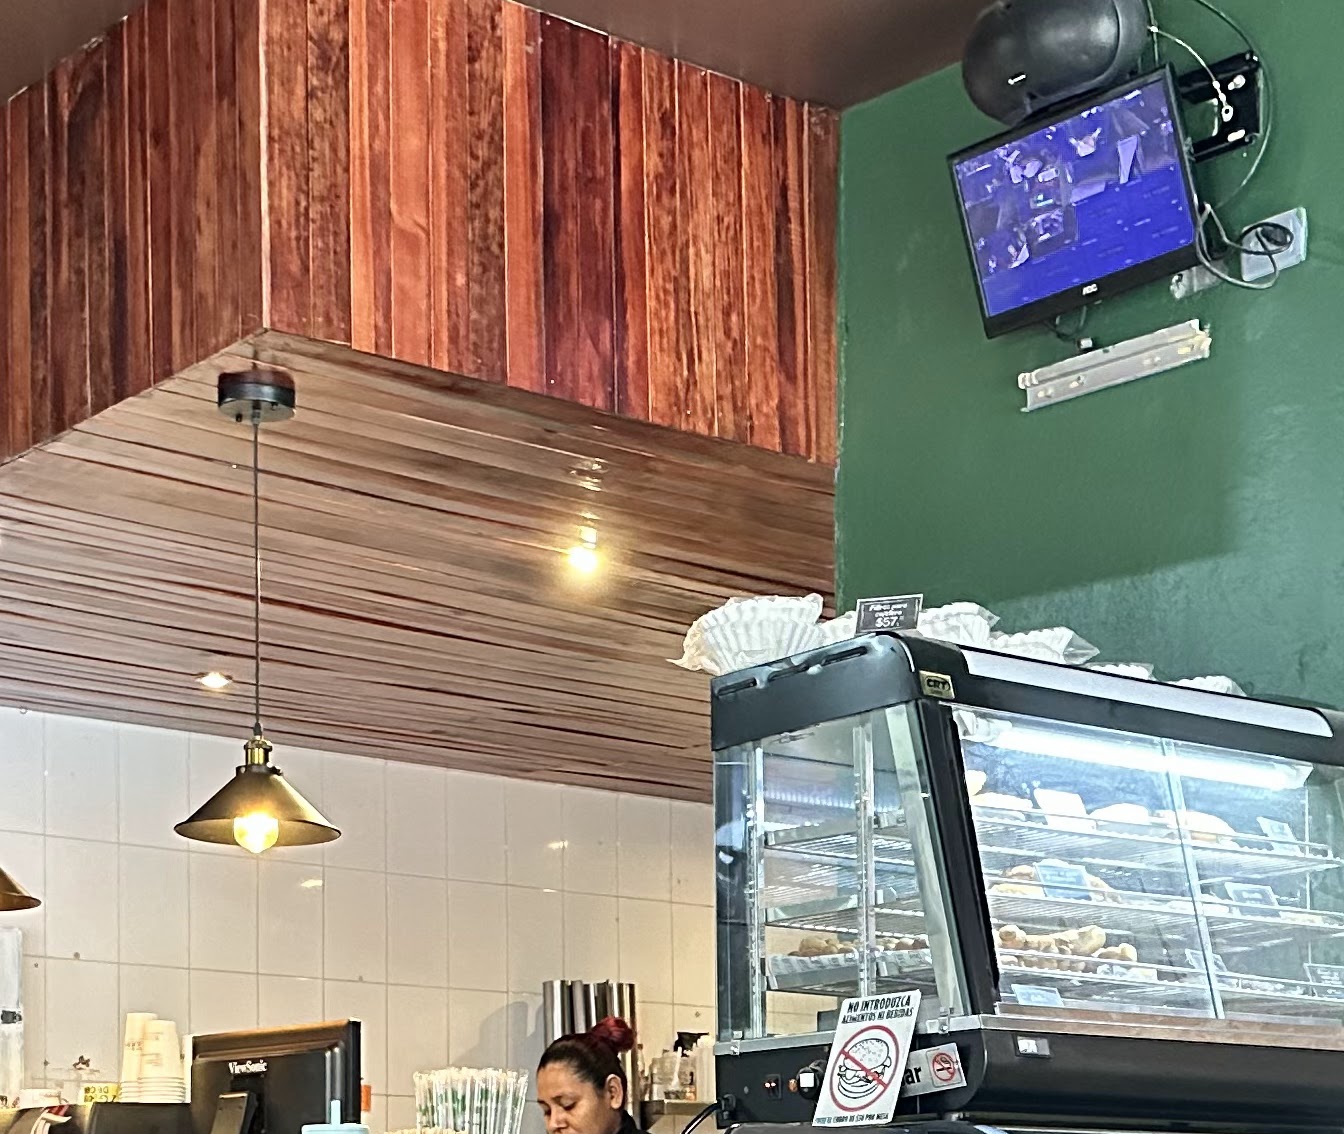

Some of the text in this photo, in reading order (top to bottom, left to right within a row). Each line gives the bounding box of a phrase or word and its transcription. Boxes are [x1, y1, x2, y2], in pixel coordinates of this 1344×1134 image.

[847, 994, 912, 1014] NO INTRODUZCA
[228, 1059, 268, 1074] ViewSonic
